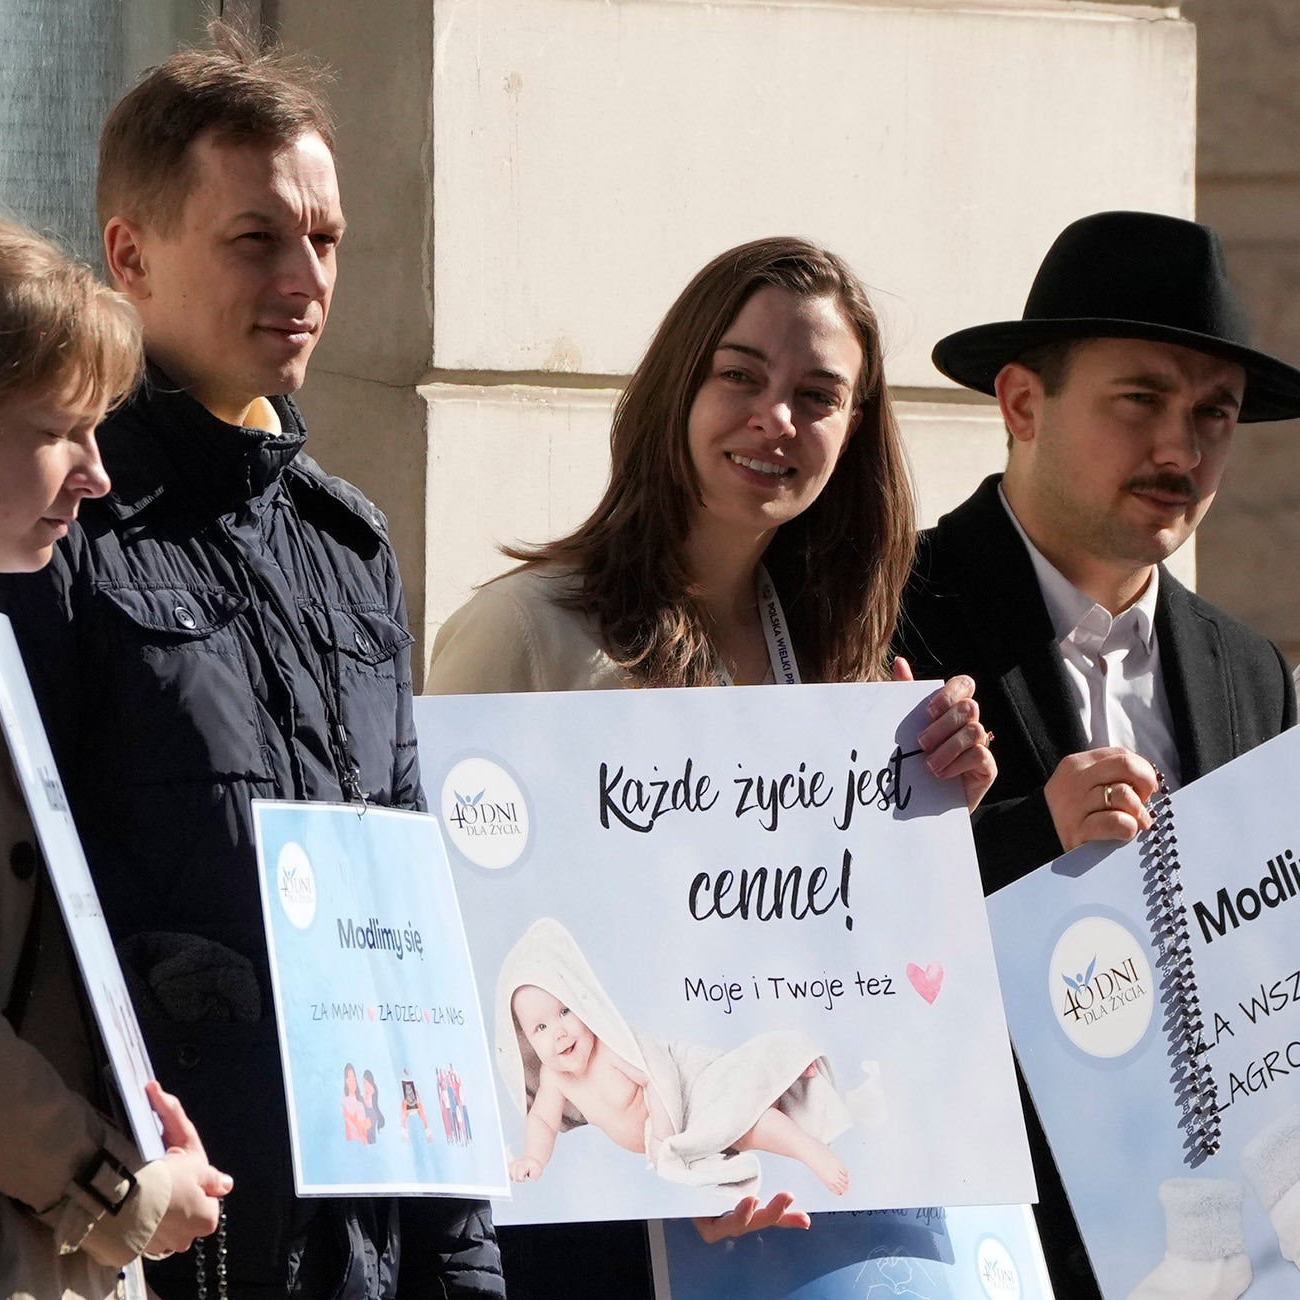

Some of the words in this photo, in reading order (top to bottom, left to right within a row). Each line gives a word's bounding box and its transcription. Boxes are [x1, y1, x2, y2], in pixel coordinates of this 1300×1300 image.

[768, 602, 782, 637] POLSKA
[777, 637, 791, 671] WIELKI
[599, 757, 719, 833] Każde
[733, 762, 833, 831] życie
[833, 745, 924, 831] jest
[450, 802, 478, 829] 40
[480, 803, 518, 823] DNI
[466, 825, 487, 836] DLA
[489, 823, 521, 836] ŻYCIA
[688, 848, 853, 931] cenne!
[336, 917, 403, 961] Modlimy
[403, 920, 424, 961] się
[684, 975, 743, 1014] Moje
[752, 975, 760, 999] i
[767, 971, 844, 1010] Twoje
[854, 971, 896, 997] też
[1063, 984, 1094, 1022] 40
[1093, 957, 1140, 1001] DNI
[311, 1003, 328, 1021] ZA
[331, 1003, 364, 1021] MAMY
[377, 1003, 393, 1021] ZA
[431, 1008, 444, 1024] ZA
[445, 1007, 464, 1026] NAS
[1083, 1004, 1108, 1025] DLA
